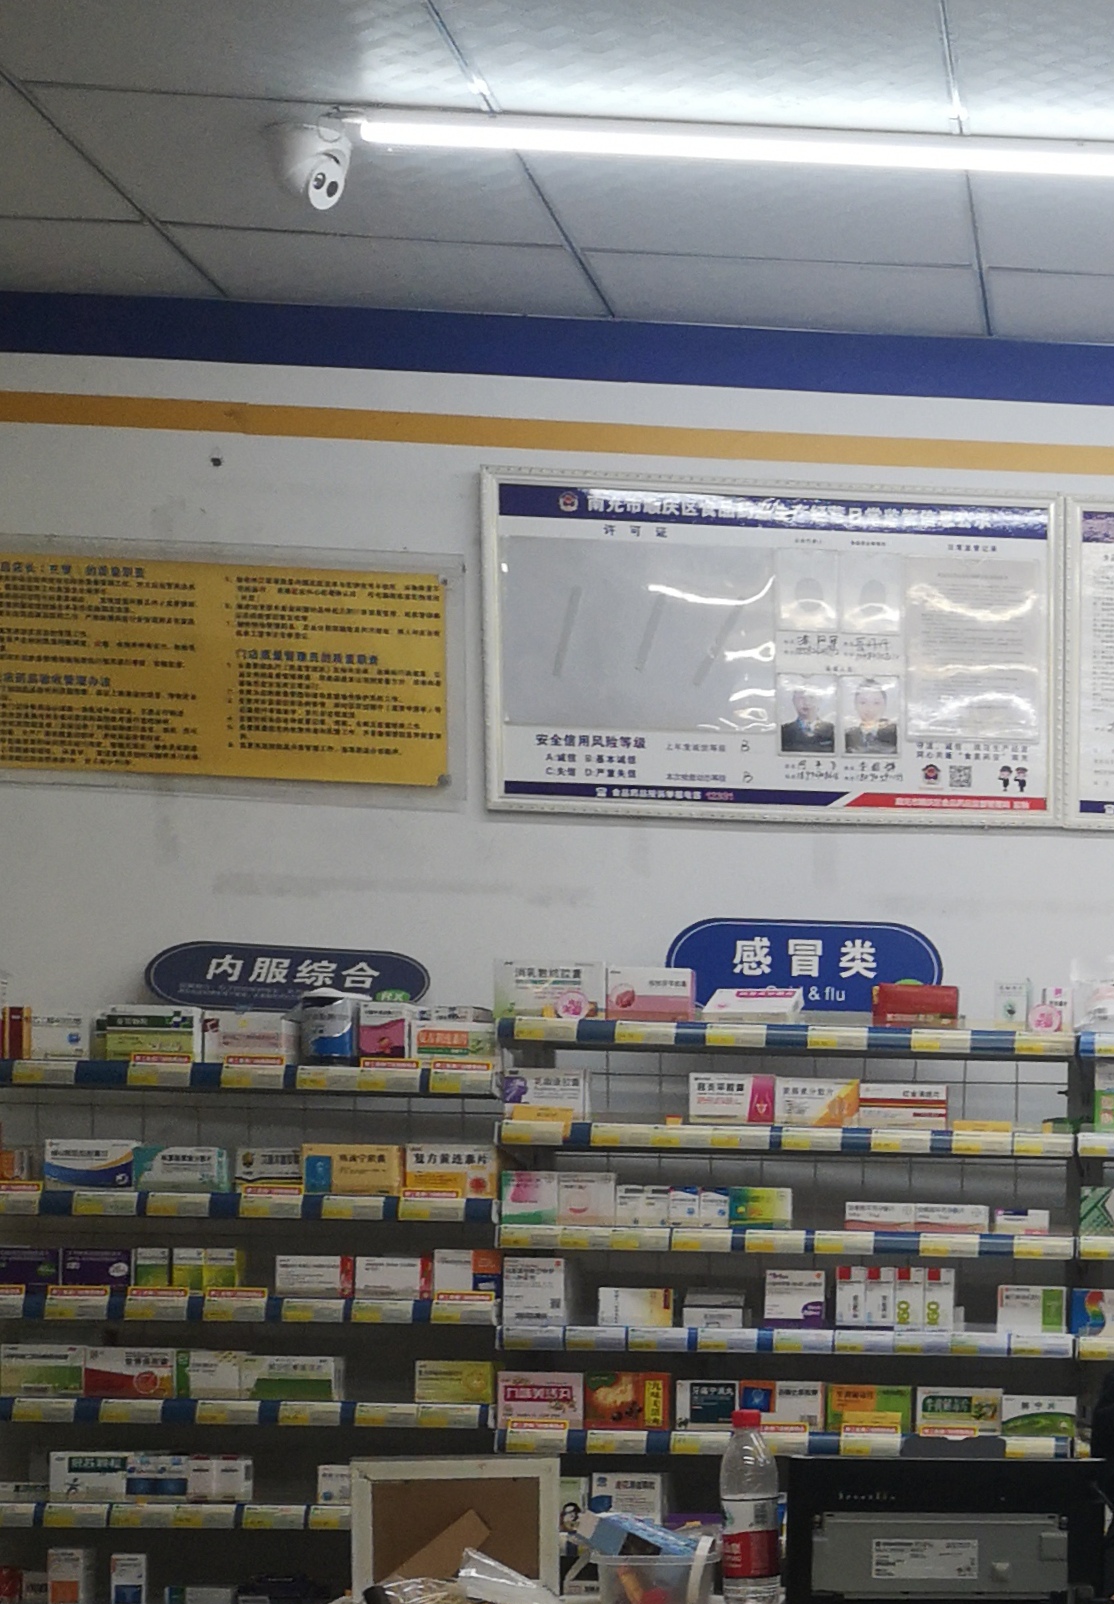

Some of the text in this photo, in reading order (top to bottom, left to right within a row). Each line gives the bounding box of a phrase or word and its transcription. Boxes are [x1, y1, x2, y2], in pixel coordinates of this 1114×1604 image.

[603, 524, 668, 538] 许可证
[535, 733, 646, 750] 安全信用风险等级
[732, 937, 879, 980] 感冒类
[205, 953, 381, 990] 内服综合
[824, 986, 846, 1002] flu
